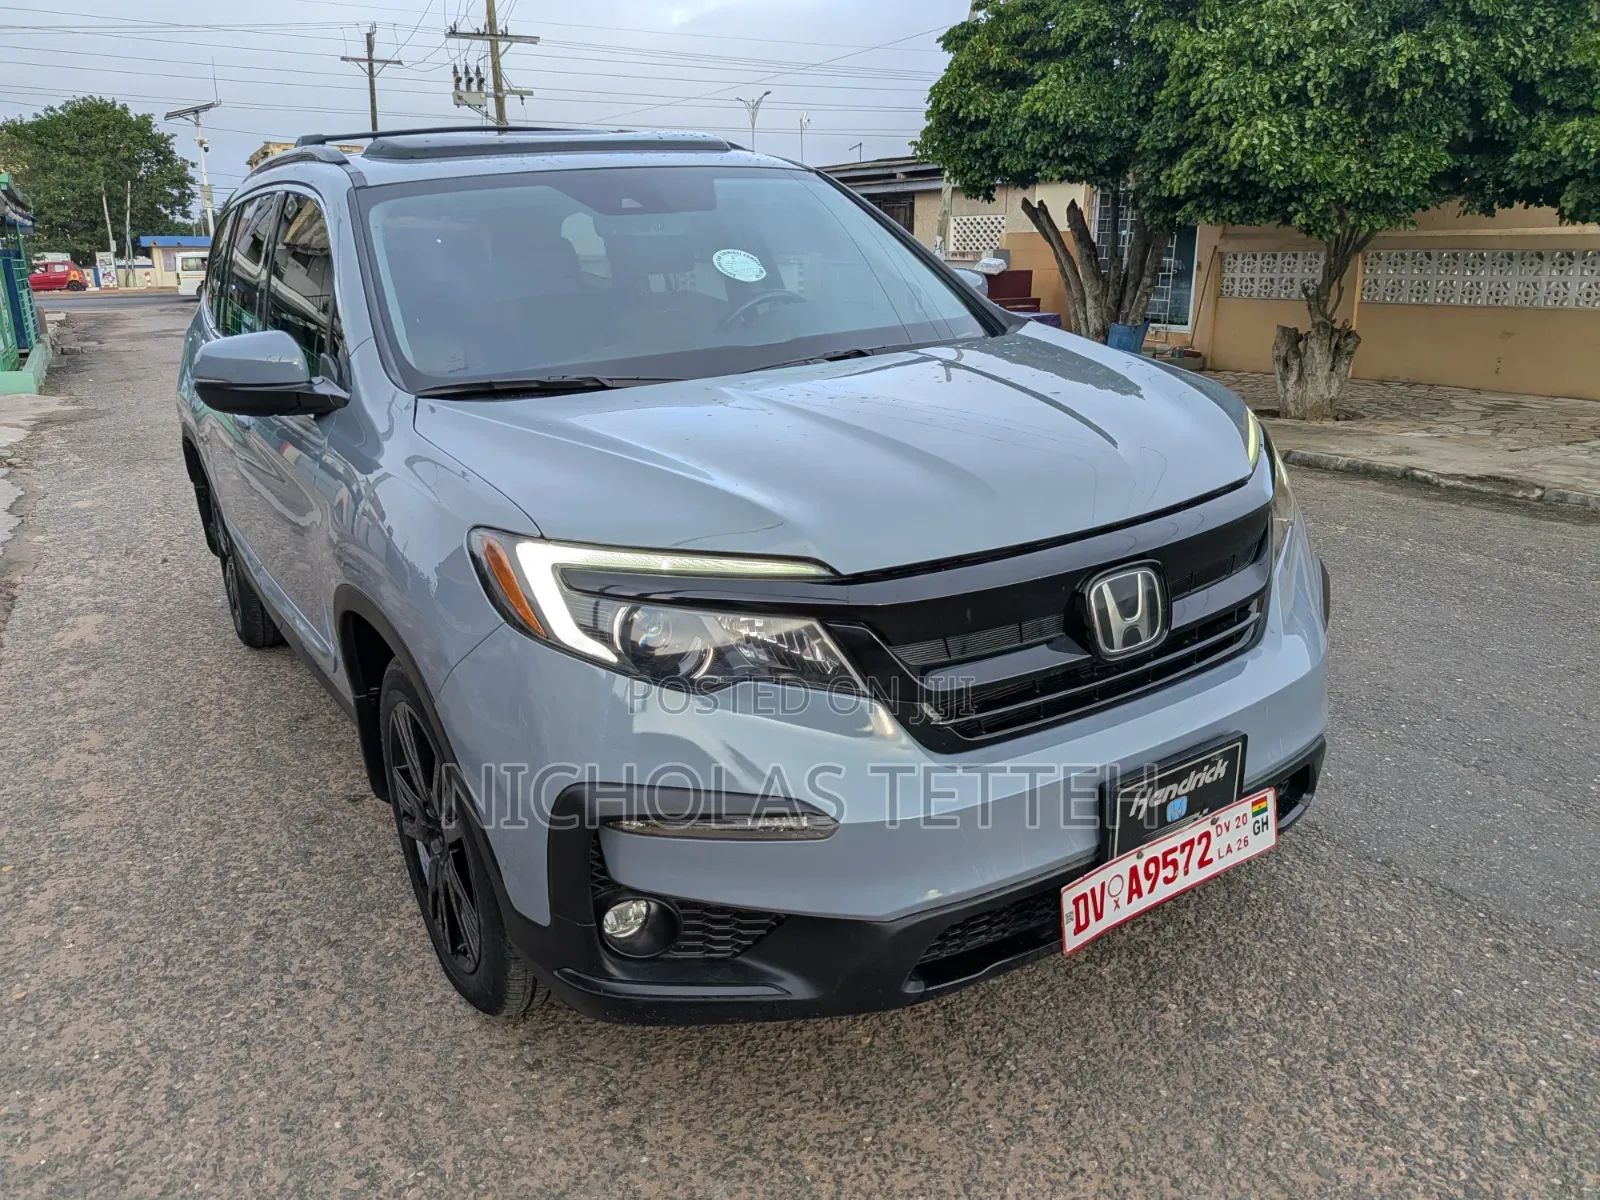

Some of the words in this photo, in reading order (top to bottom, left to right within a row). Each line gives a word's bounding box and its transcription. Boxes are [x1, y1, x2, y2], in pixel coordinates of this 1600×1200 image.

[1128, 759, 1229, 821] Hendrick
[1215, 820, 1231, 838] DV
[1235, 812, 1248, 829] 20
[1252, 815, 1269, 836] GH
[1217, 843, 1233, 860] LA
[1236, 835, 1249, 851] 26
[1072, 880, 1106, 936] DV
[1127, 830, 1214, 905] A9572
